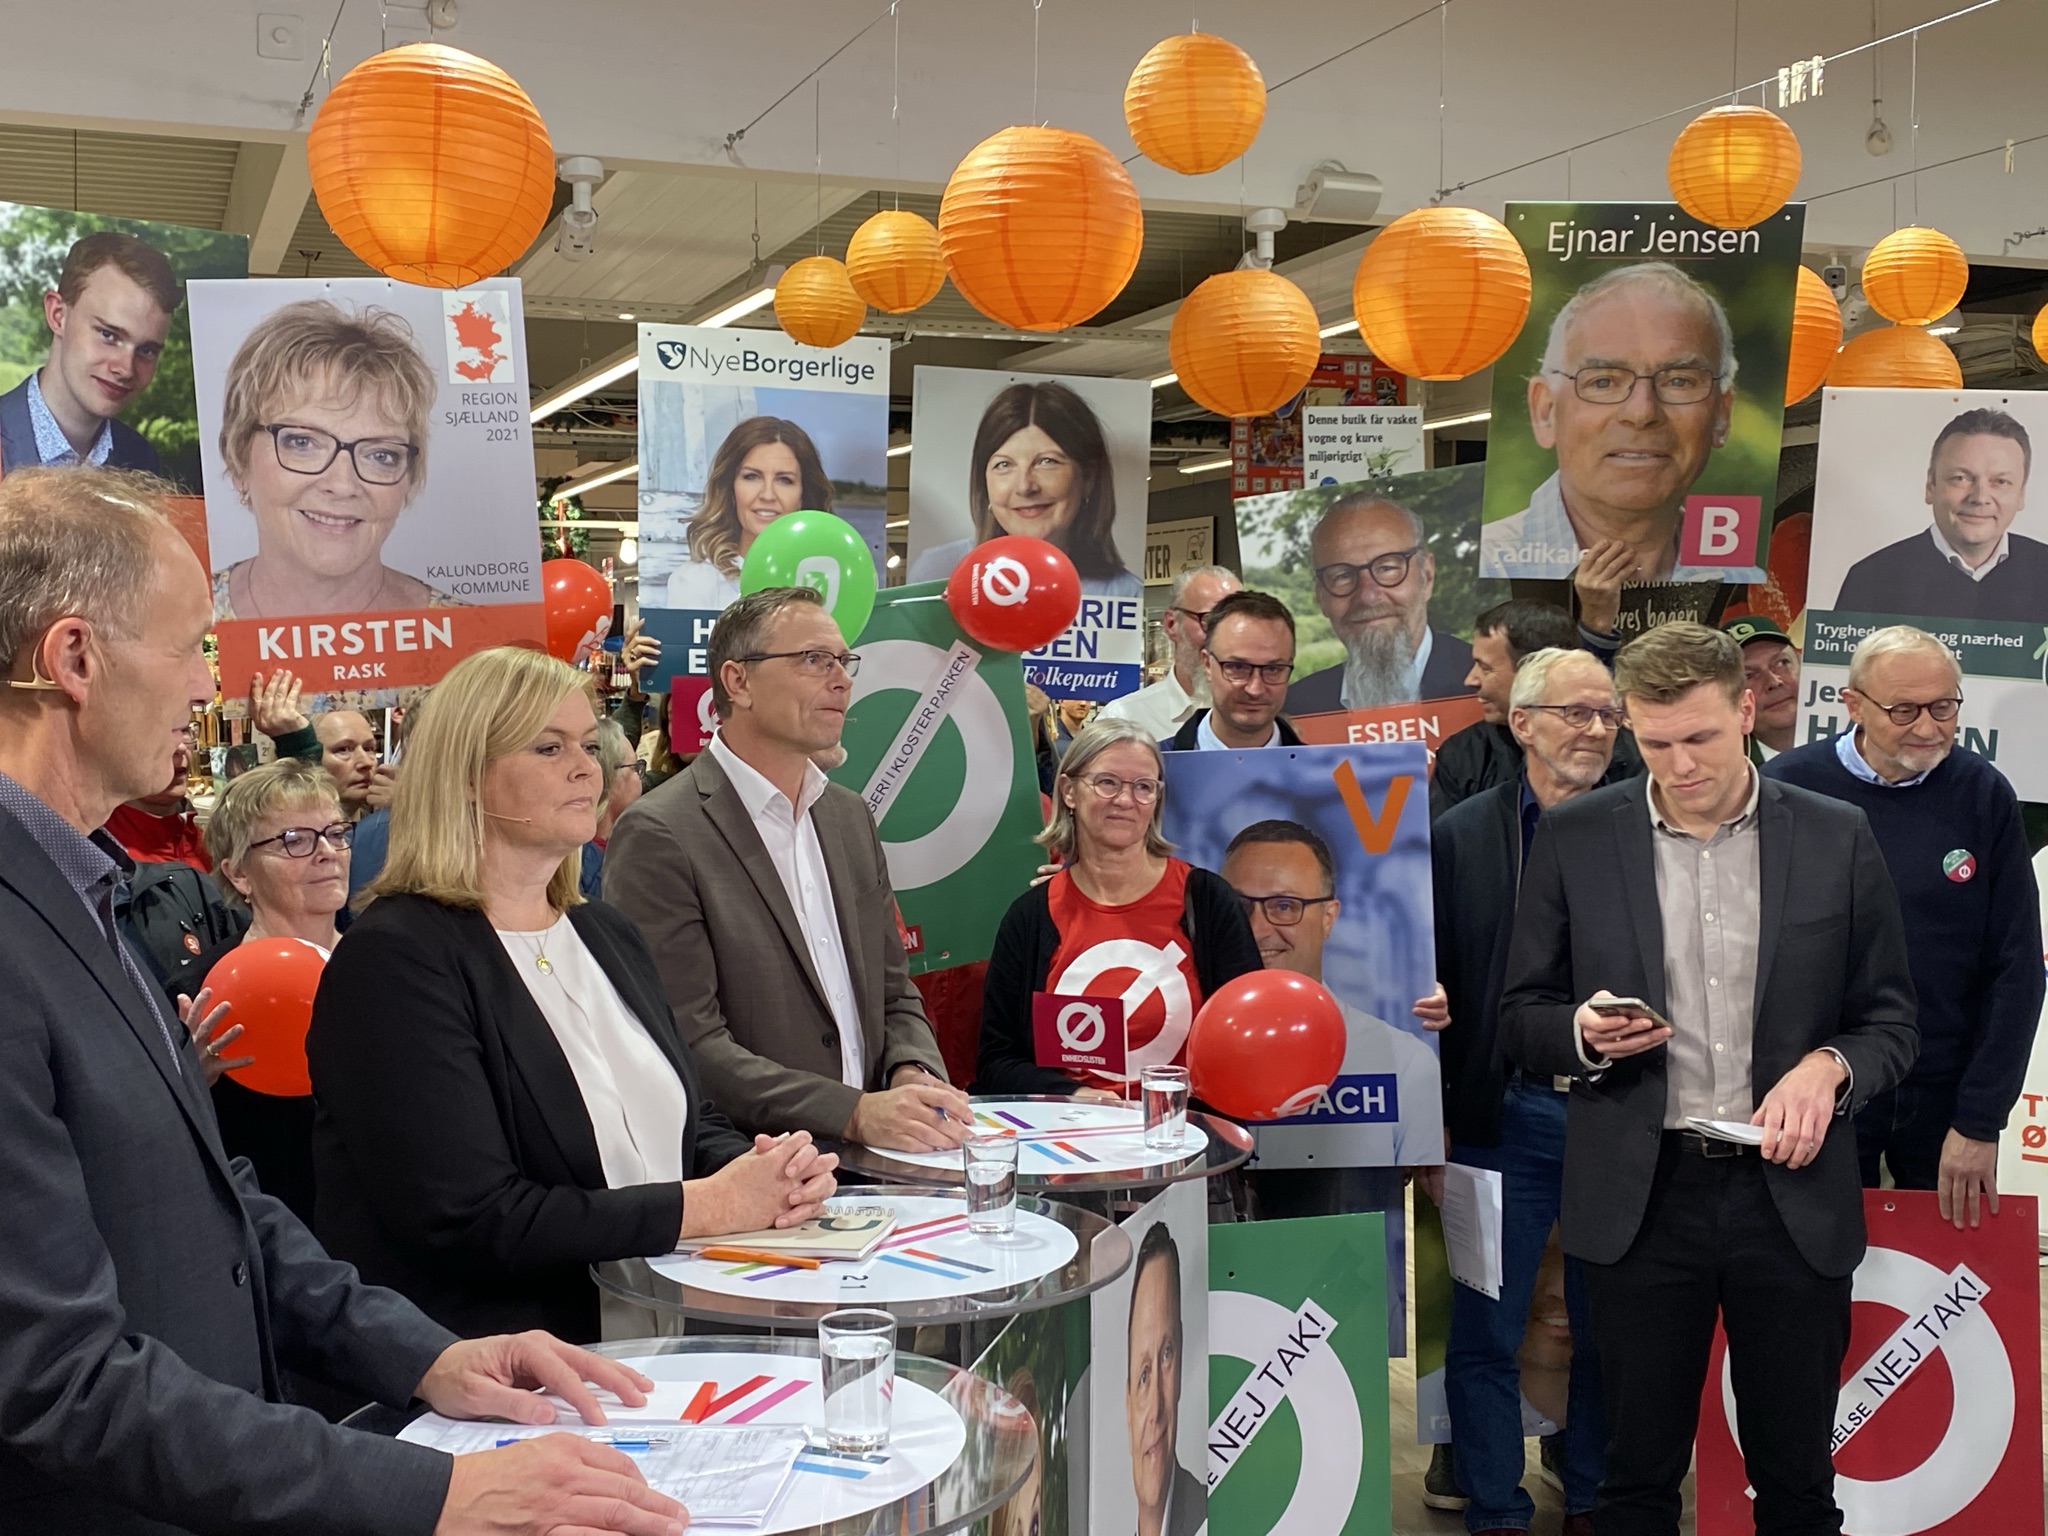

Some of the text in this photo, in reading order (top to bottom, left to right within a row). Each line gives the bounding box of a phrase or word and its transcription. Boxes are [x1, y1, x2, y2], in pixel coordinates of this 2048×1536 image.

[1547, 220, 1761, 262] Ejnar Jensen
[689, 346, 875, 386] NyeBorgerlige
[461, 391, 518, 406] REGION
[445, 410, 519, 427] SJÆLLAND
[1308, 413, 1418, 425] Denne butik får vasket
[486, 428, 519, 442] 2021
[1308, 432, 1384, 446] vogne og kurve
[1309, 469, 1319, 481] af
[1699, 506, 1740, 556] B
[426, 561, 530, 579] KALUNDBORG
[1144, 544, 1171, 579] TER
[451, 579, 530, 595] KOMMUNE
[257, 616, 453, 661] KIRSTEN
[1814, 638, 1840, 652] Din
[1939, 632, 1959, 647] og
[1962, 633, 2024, 648] nærhed
[333, 662, 387, 680] RASK
[1024, 665, 1119, 692] Folkeparti
[891, 708, 937, 774] KLOSTER
[931, 650, 971, 709] PARKEN
[1347, 715, 1441, 744] ESBEN
[1332, 758, 1415, 855] V
[1299, 1085, 1386, 1116] ACH
[1863, 1337, 1922, 1398] NEJ
[1913, 1275, 1983, 1340] TAK!
[1208, 1311, 1327, 1464] NEJ TAK!
